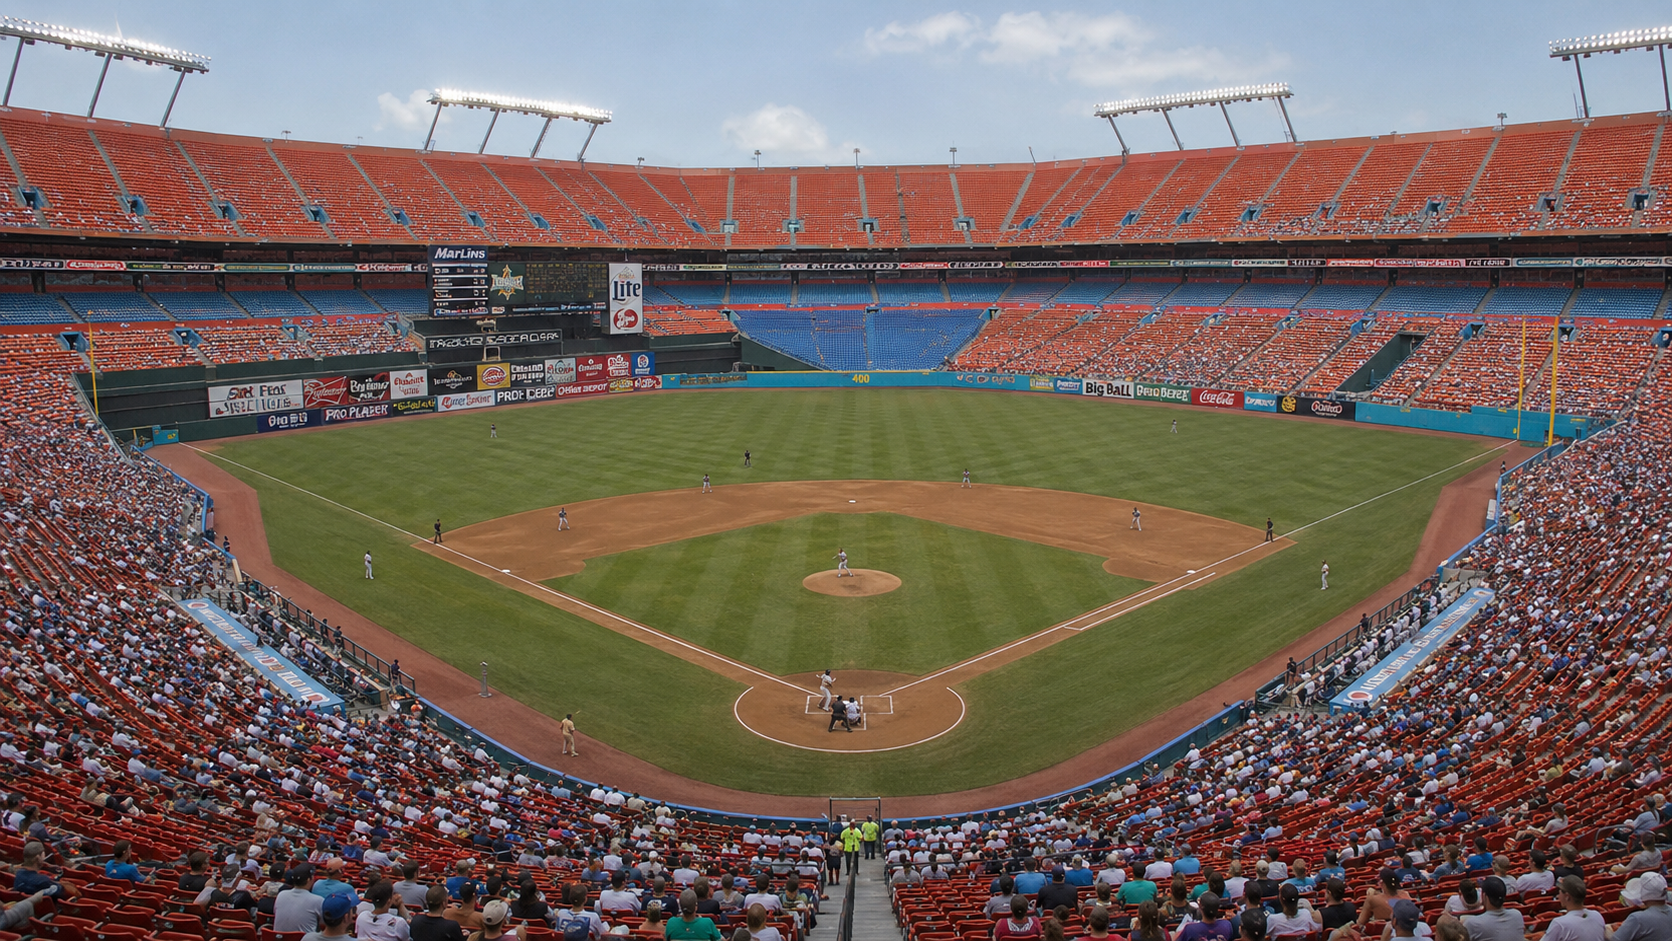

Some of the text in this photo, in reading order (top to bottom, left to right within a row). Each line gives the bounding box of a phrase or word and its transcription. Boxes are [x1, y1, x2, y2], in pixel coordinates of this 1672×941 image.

[612, 281, 641, 301] Lite
[852, 374, 870, 383] 400
[1085, 382, 1104, 396] Big
